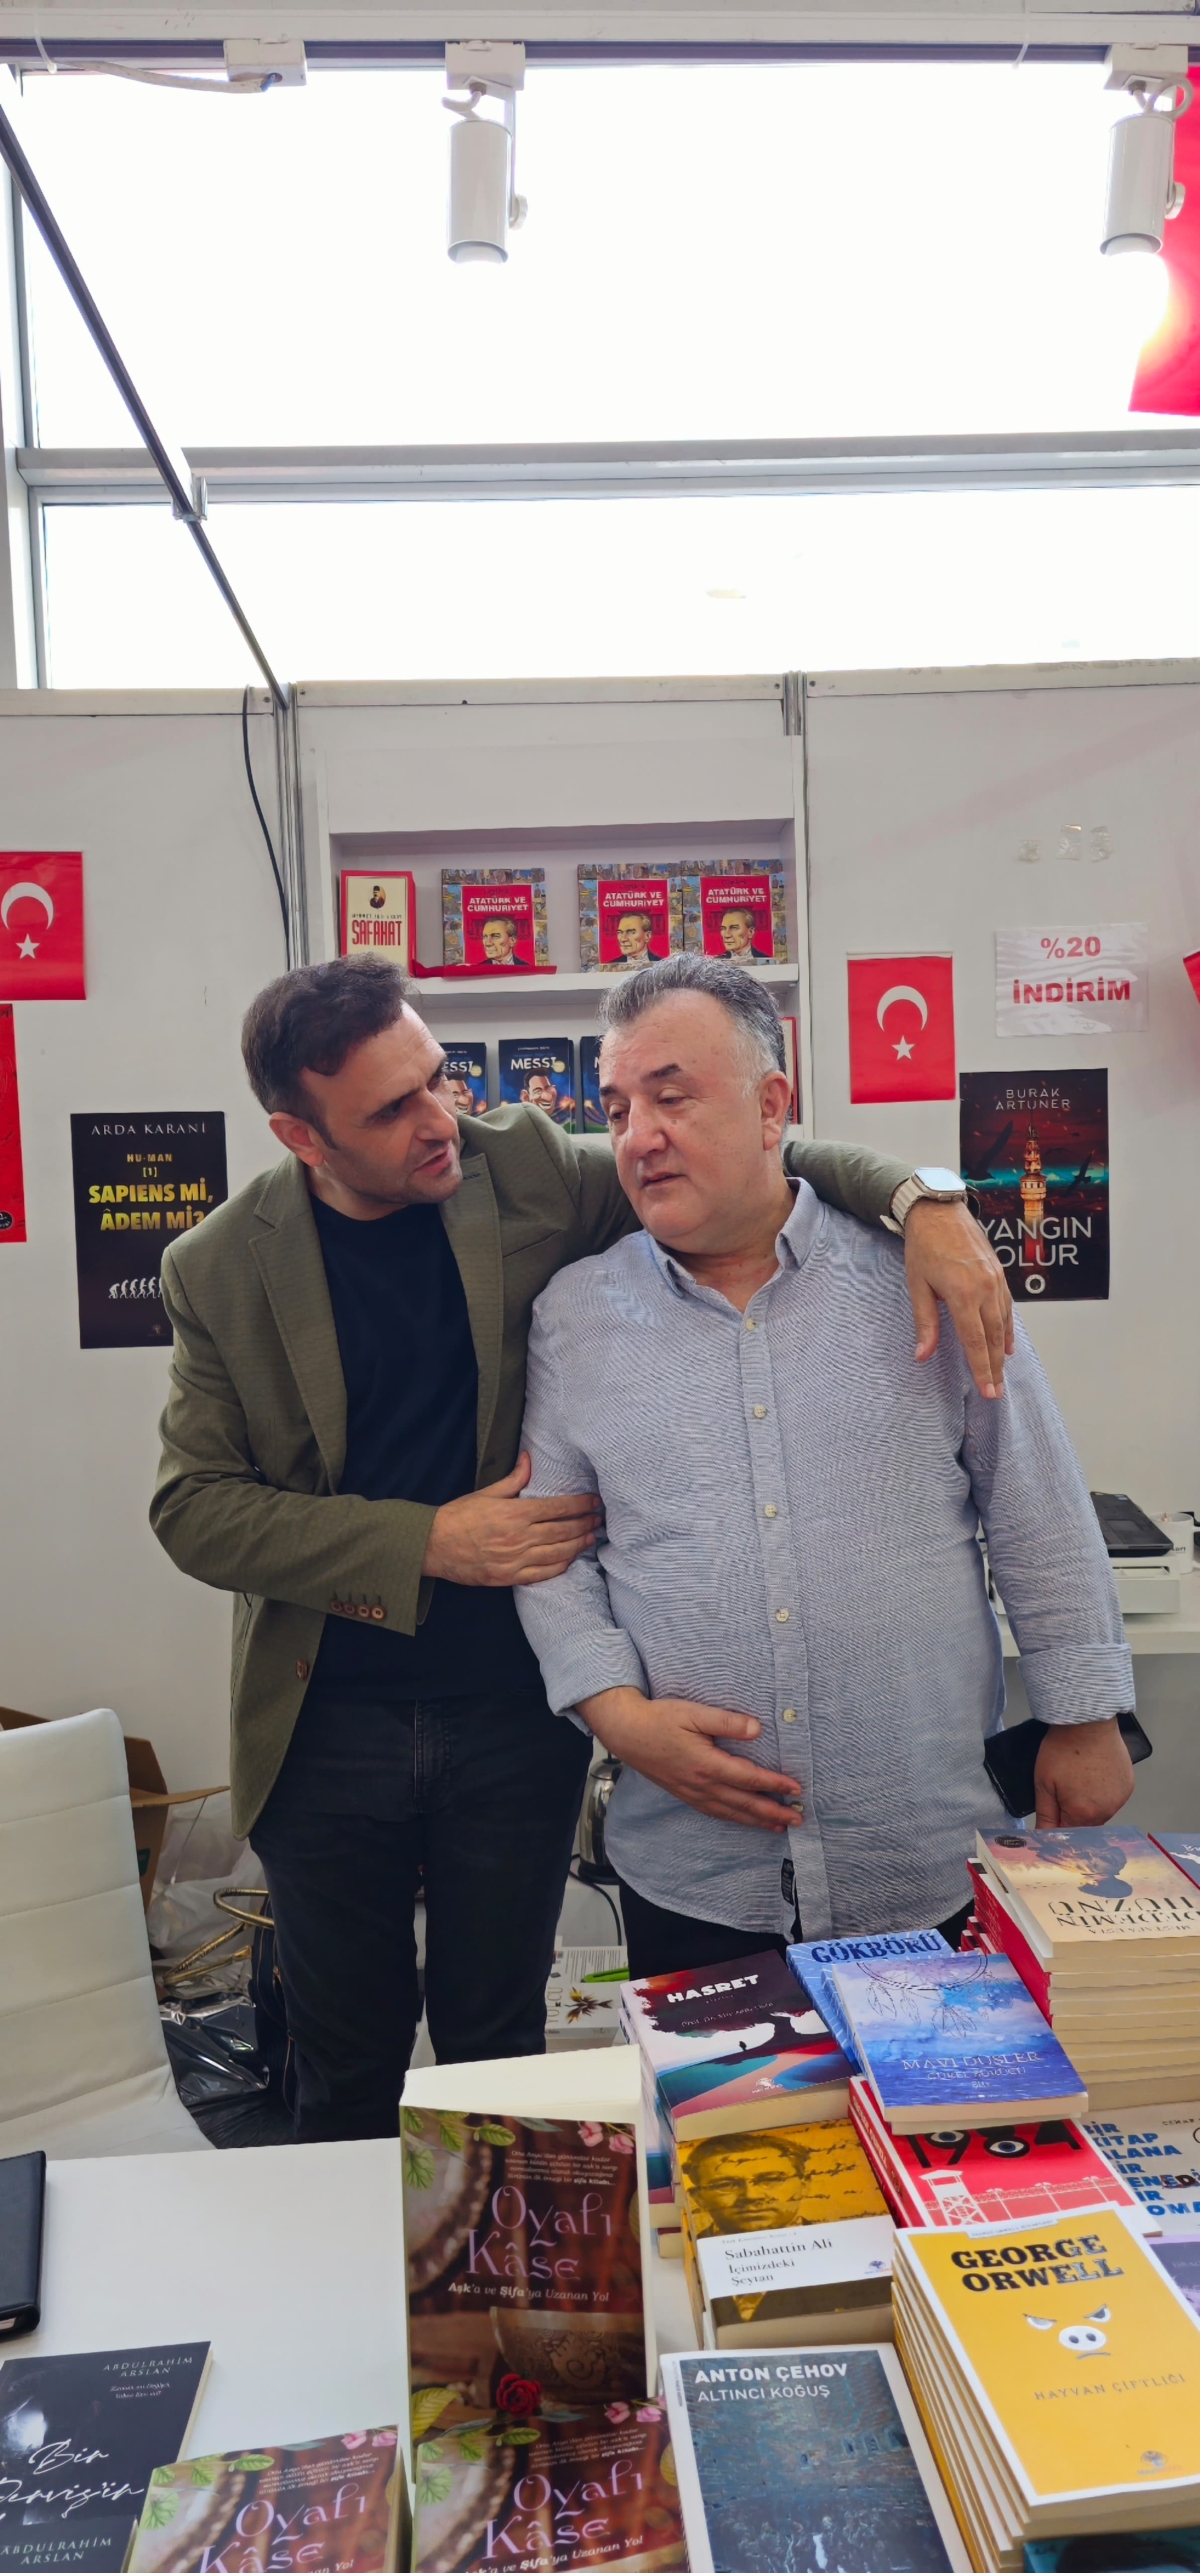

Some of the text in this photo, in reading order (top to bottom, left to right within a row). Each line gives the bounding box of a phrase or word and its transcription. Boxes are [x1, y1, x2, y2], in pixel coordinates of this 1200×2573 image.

[470, 895, 526, 905] ATATÜRK VE
[605, 891, 647, 900] ATATÜRK
[708, 886, 750, 896] ATATÜRK
[352, 920, 402, 946] SAFAHAT
[1040, 936, 1101, 959] %20
[1013, 976, 1130, 1004] İNDİRİM
[996, 1099, 1071, 1110] ARTUNER
[1006, 1088, 1060, 1099] BURAK
[92, 1122, 206, 1136] ARDA KARANİ
[127, 1154, 172, 1163] HU-MAN
[143, 1167, 158, 1178] [1]
[88, 1178, 213, 1204] SAPIENS Mİ,
[101, 1208, 160, 1230] ÂDEM
[978, 1216, 1092, 1240] YANGIN
[995, 1244, 1079, 1268] OLUR
[812, 1933, 942, 1963] GÖKBÖRÜ
[666, 1974, 758, 2003] HASRET
[492, 2186, 612, 2247] Oyalı
[465, 2229, 580, 2280] Kâse
[725, 2242, 806, 2260] Sabahattin
[811, 2238, 833, 2250] Ali
[950, 2234, 1107, 2269] GEORGE
[732, 2274, 774, 2286] Şeytan
[962, 2258, 1124, 2292] ORWELL
[448, 2282, 480, 2295] Aşk'a
[500, 2286, 542, 2300] Şifa'ya
[546, 2289, 588, 2300] Uzanan
[592, 2292, 610, 2302] Yol
[120, 2367, 171, 2378] ARSLAN
[694, 2363, 848, 2384] ANTON ÇEHOV
[698, 2384, 830, 2402] ALTINCI KOĞUŞ
[1034, 2384, 1106, 2400] HAYVAN
[28, 2438, 109, 2475] Bir
[514, 2459, 643, 2520] Oyalı
[236, 2482, 366, 2546] Oyalı
[482, 2514, 610, 2559] Kâse
[572, 2544, 620, 2559] Uzanan
[624, 2535, 644, 2548] Yol
[21, 2552, 84, 2565] ARSLAN
[199, 2541, 326, 2573] Kâse
[336, 2559, 354, 2572] Yol
